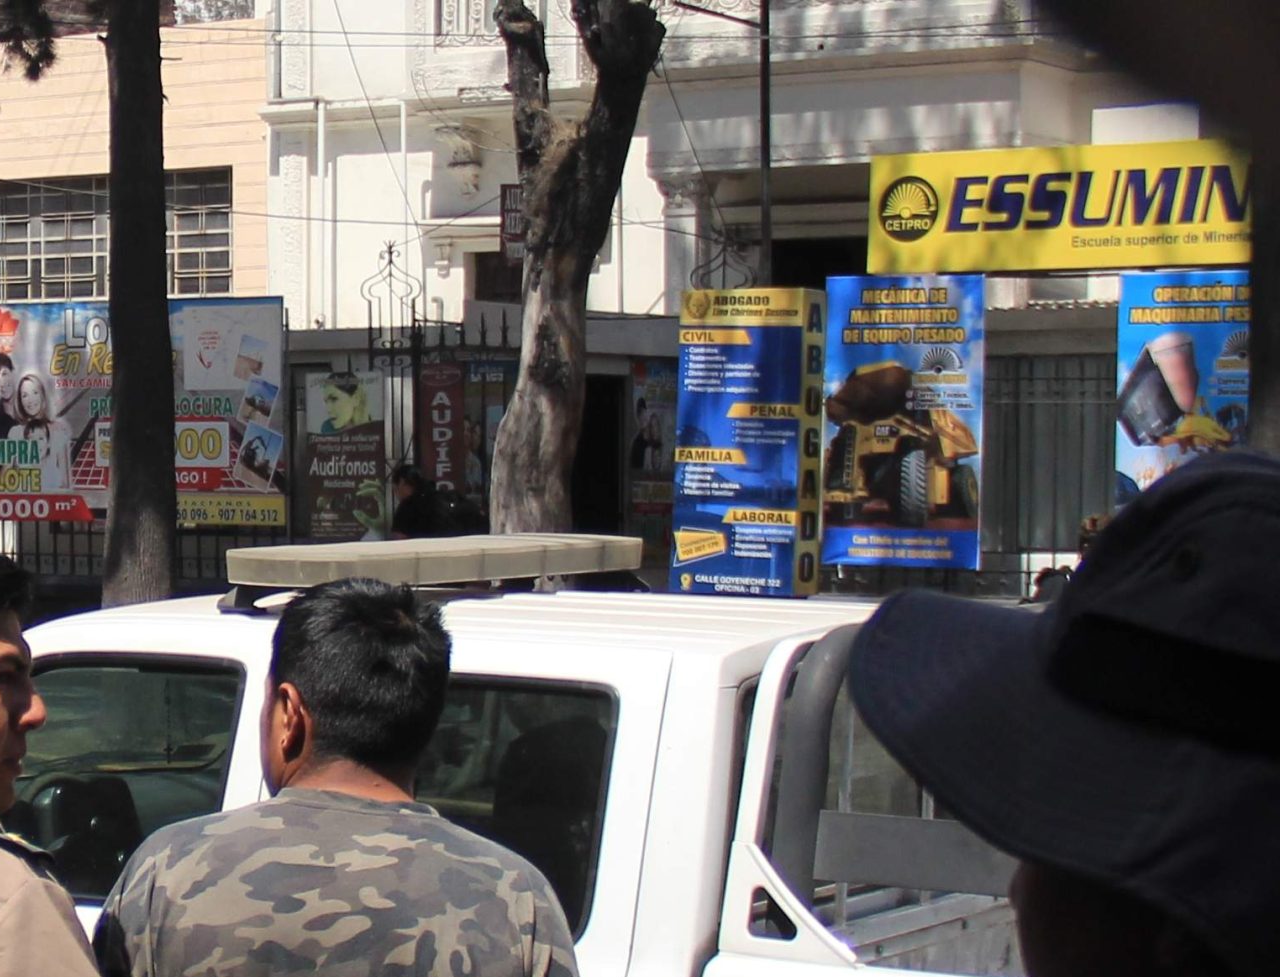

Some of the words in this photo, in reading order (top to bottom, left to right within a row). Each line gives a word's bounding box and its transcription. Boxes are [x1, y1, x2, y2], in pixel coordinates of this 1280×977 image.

[944, 164, 1251, 232] ESSUMIN
[885, 219, 931, 231] CETPRO
[1125, 232, 1179, 247] superior
[1183, 232, 1198, 245] de
[713, 296, 770, 306] ABOGADO
[928, 288, 947, 304] DE
[849, 308, 958, 324] MANTENIMIENTO
[1129, 307, 1220, 324] MAQUINARIA
[682, 331, 715, 342] CIVIL
[843, 328, 861, 344] DE
[862, 327, 913, 344] EQUIPO
[914, 327, 965, 344] PESADO
[50, 345, 81, 376] En
[749, 405, 795, 417] PENAL
[176, 428, 222, 460] 00
[677, 450, 733, 461] FAMILIA
[733, 511, 793, 524] LABORAL
[694, 574, 719, 584] CALLE
[714, 584, 745, 593] OFICINA
